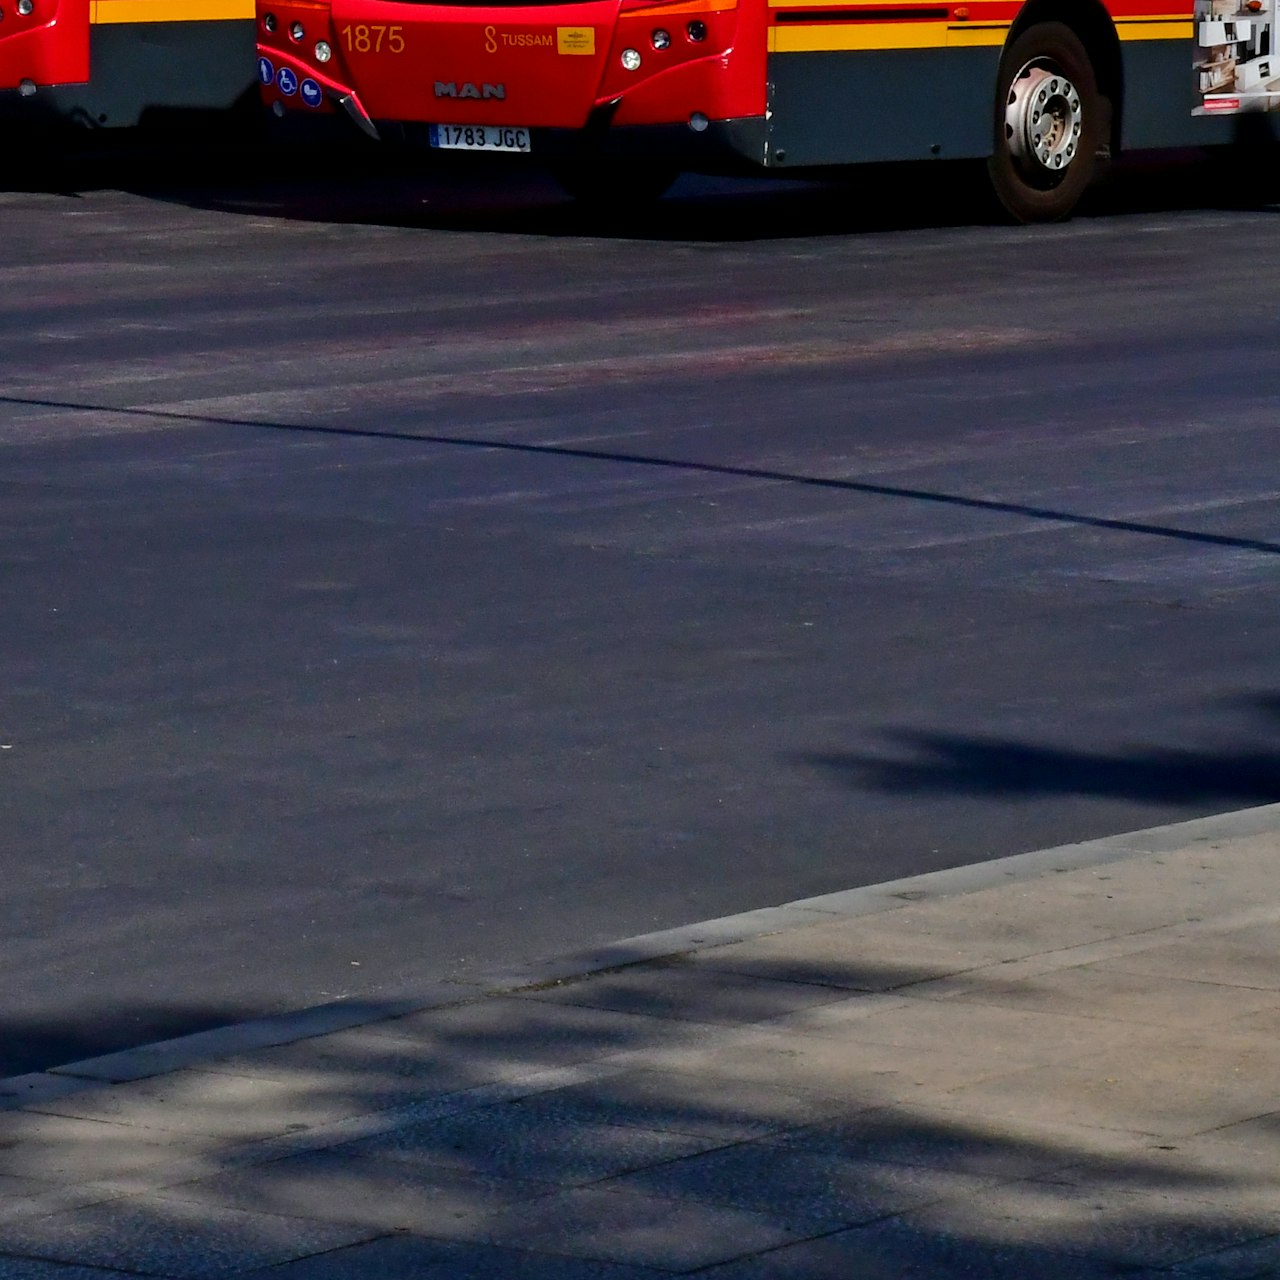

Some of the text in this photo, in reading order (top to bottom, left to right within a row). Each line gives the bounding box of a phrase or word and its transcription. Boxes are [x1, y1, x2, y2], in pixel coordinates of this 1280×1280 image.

[342, 25, 405, 53] 1875
[501, 34, 553, 46] TUSSAM
[434, 81, 505, 99] MAN
[444, 127, 526, 148] 1783 JGC
